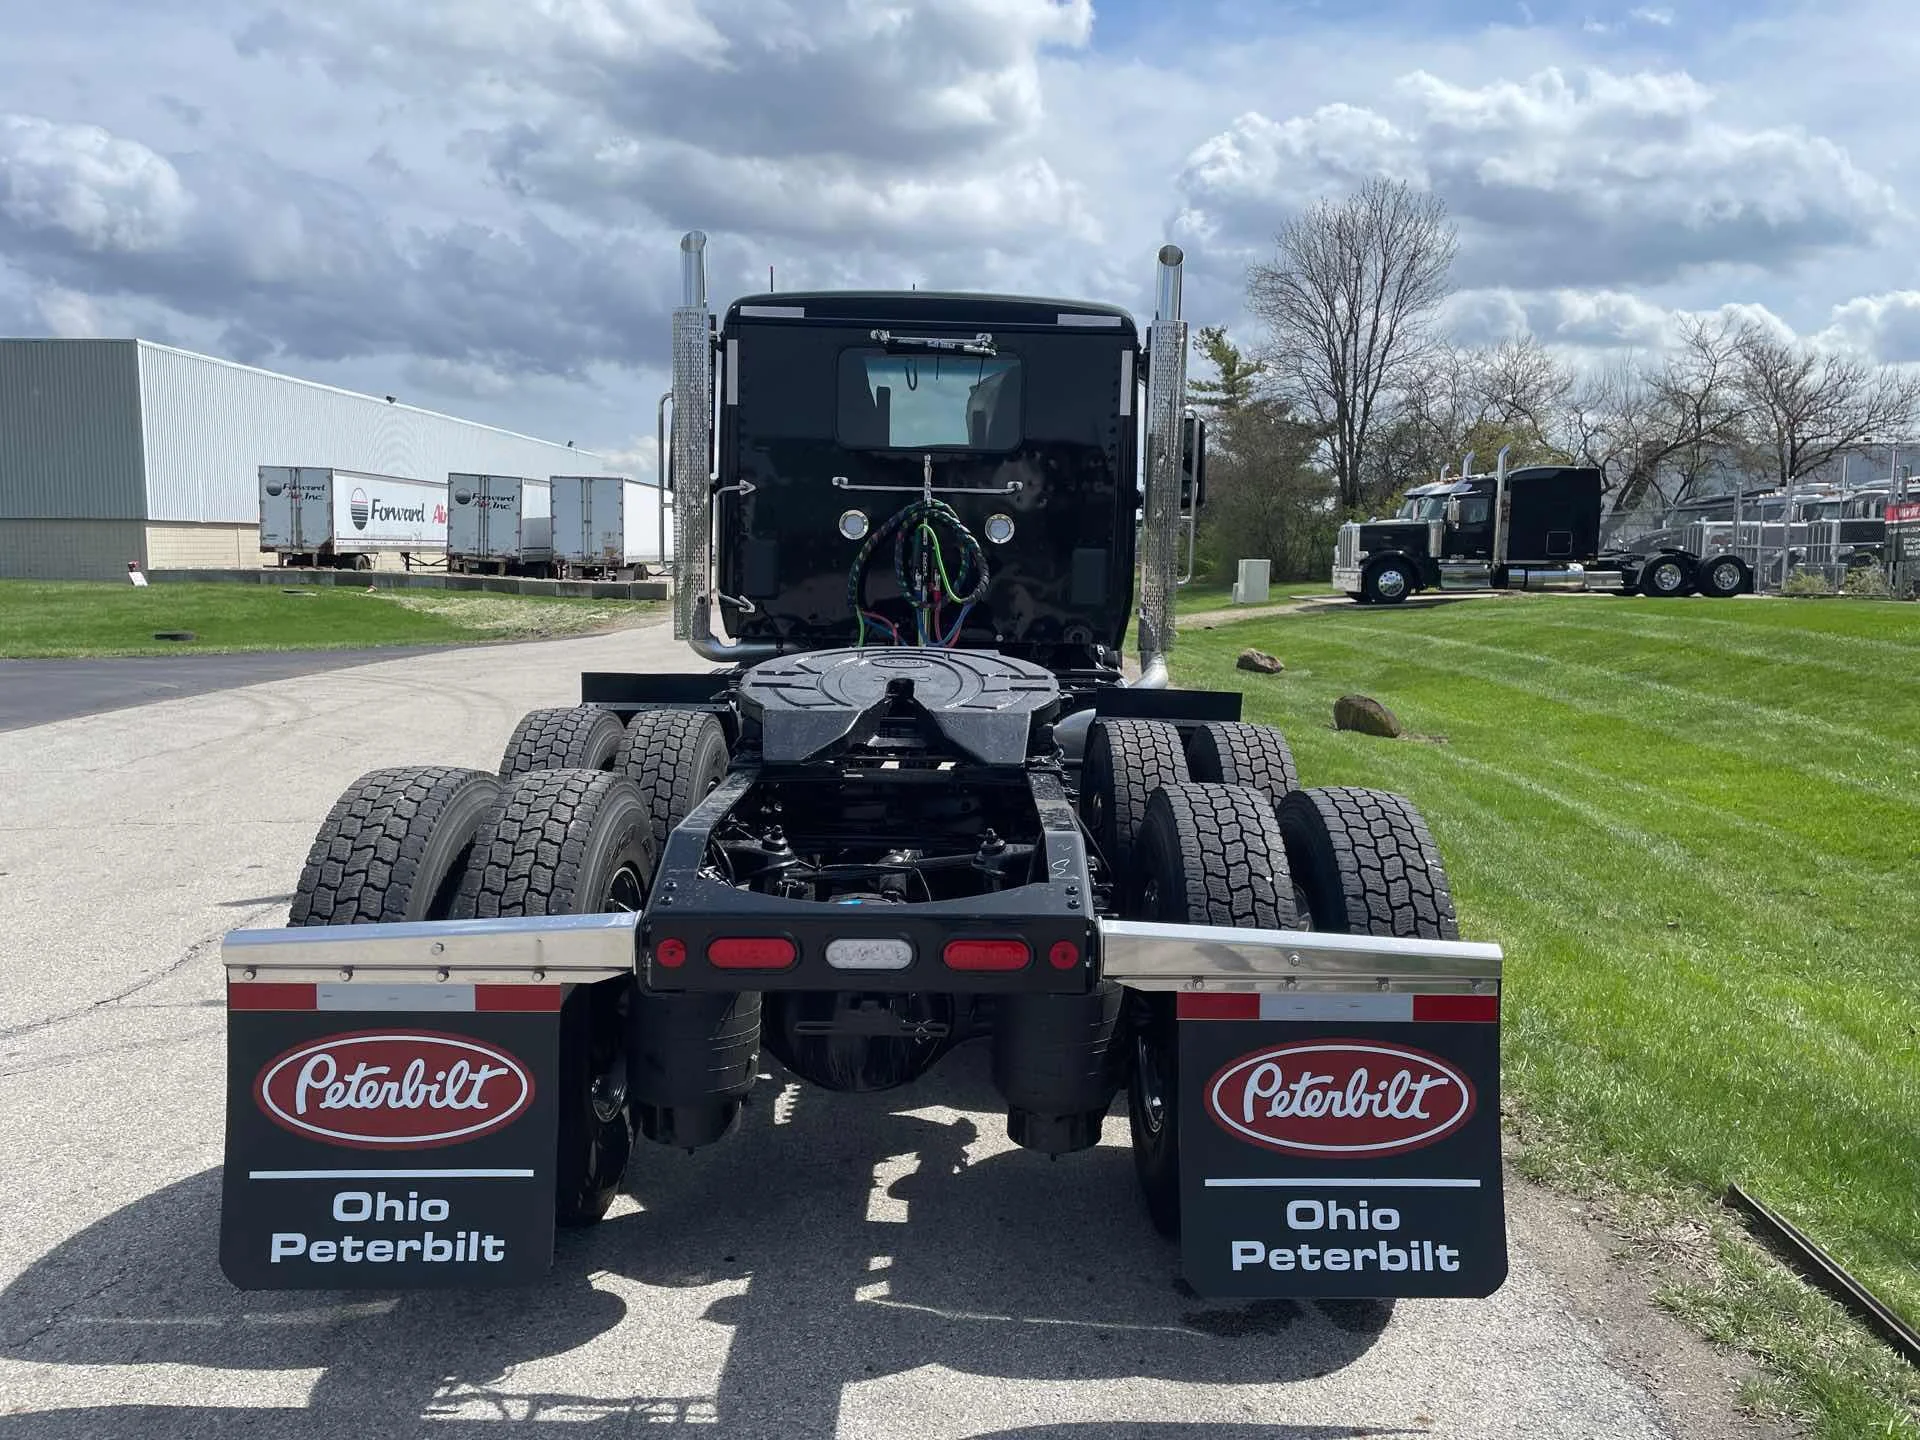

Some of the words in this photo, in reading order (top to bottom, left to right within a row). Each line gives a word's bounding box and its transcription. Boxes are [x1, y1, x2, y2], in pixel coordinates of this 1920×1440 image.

[371, 498, 425, 522] Forward
[296, 1053, 508, 1115] Peterbilt
[1243, 1062, 1449, 1123] Peterbilt
[332, 1191, 450, 1222] Ohio
[1286, 1200, 1400, 1231] Ohio
[270, 1231, 505, 1263] Peterbilt
[1231, 1240, 1460, 1272] Peterbilt
